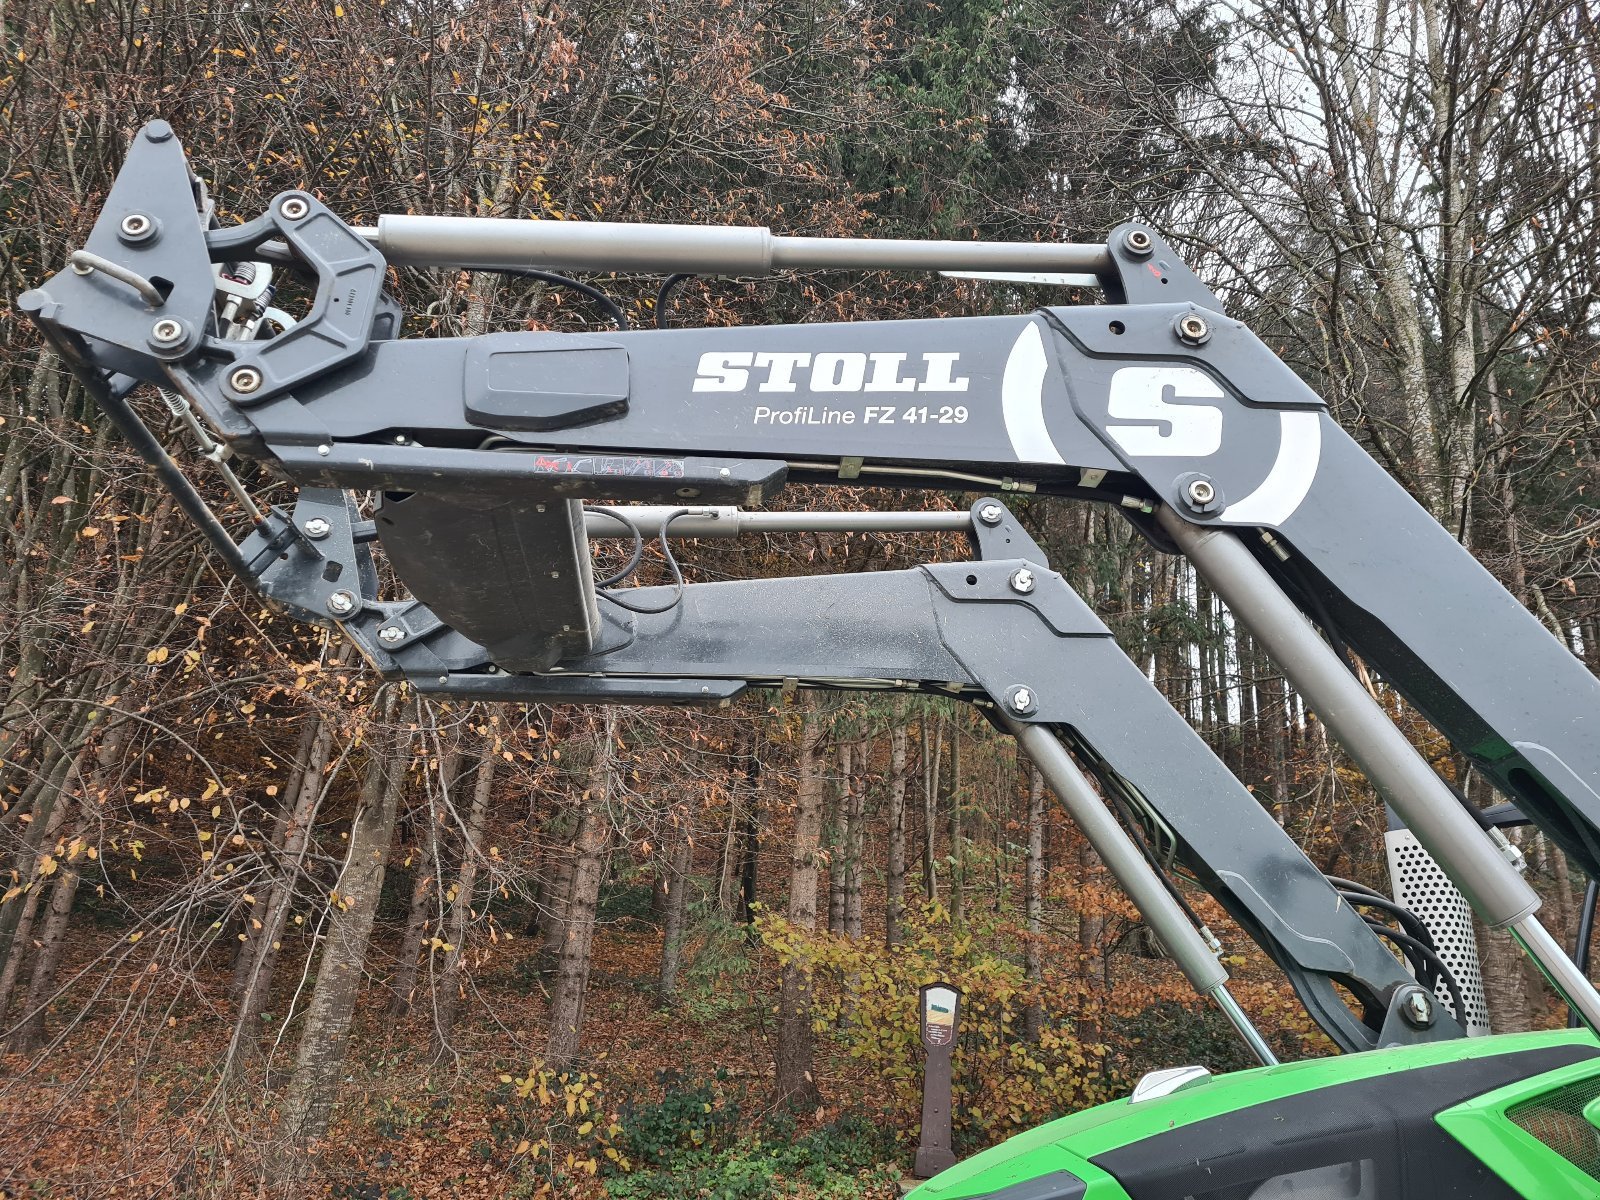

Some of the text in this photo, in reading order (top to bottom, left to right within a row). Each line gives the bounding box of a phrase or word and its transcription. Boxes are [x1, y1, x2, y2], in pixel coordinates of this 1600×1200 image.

[692, 352, 969, 392] STOLL
[754, 406, 969, 424] ProfiLine FZ 41-29
[1106, 367, 1224, 456] S
